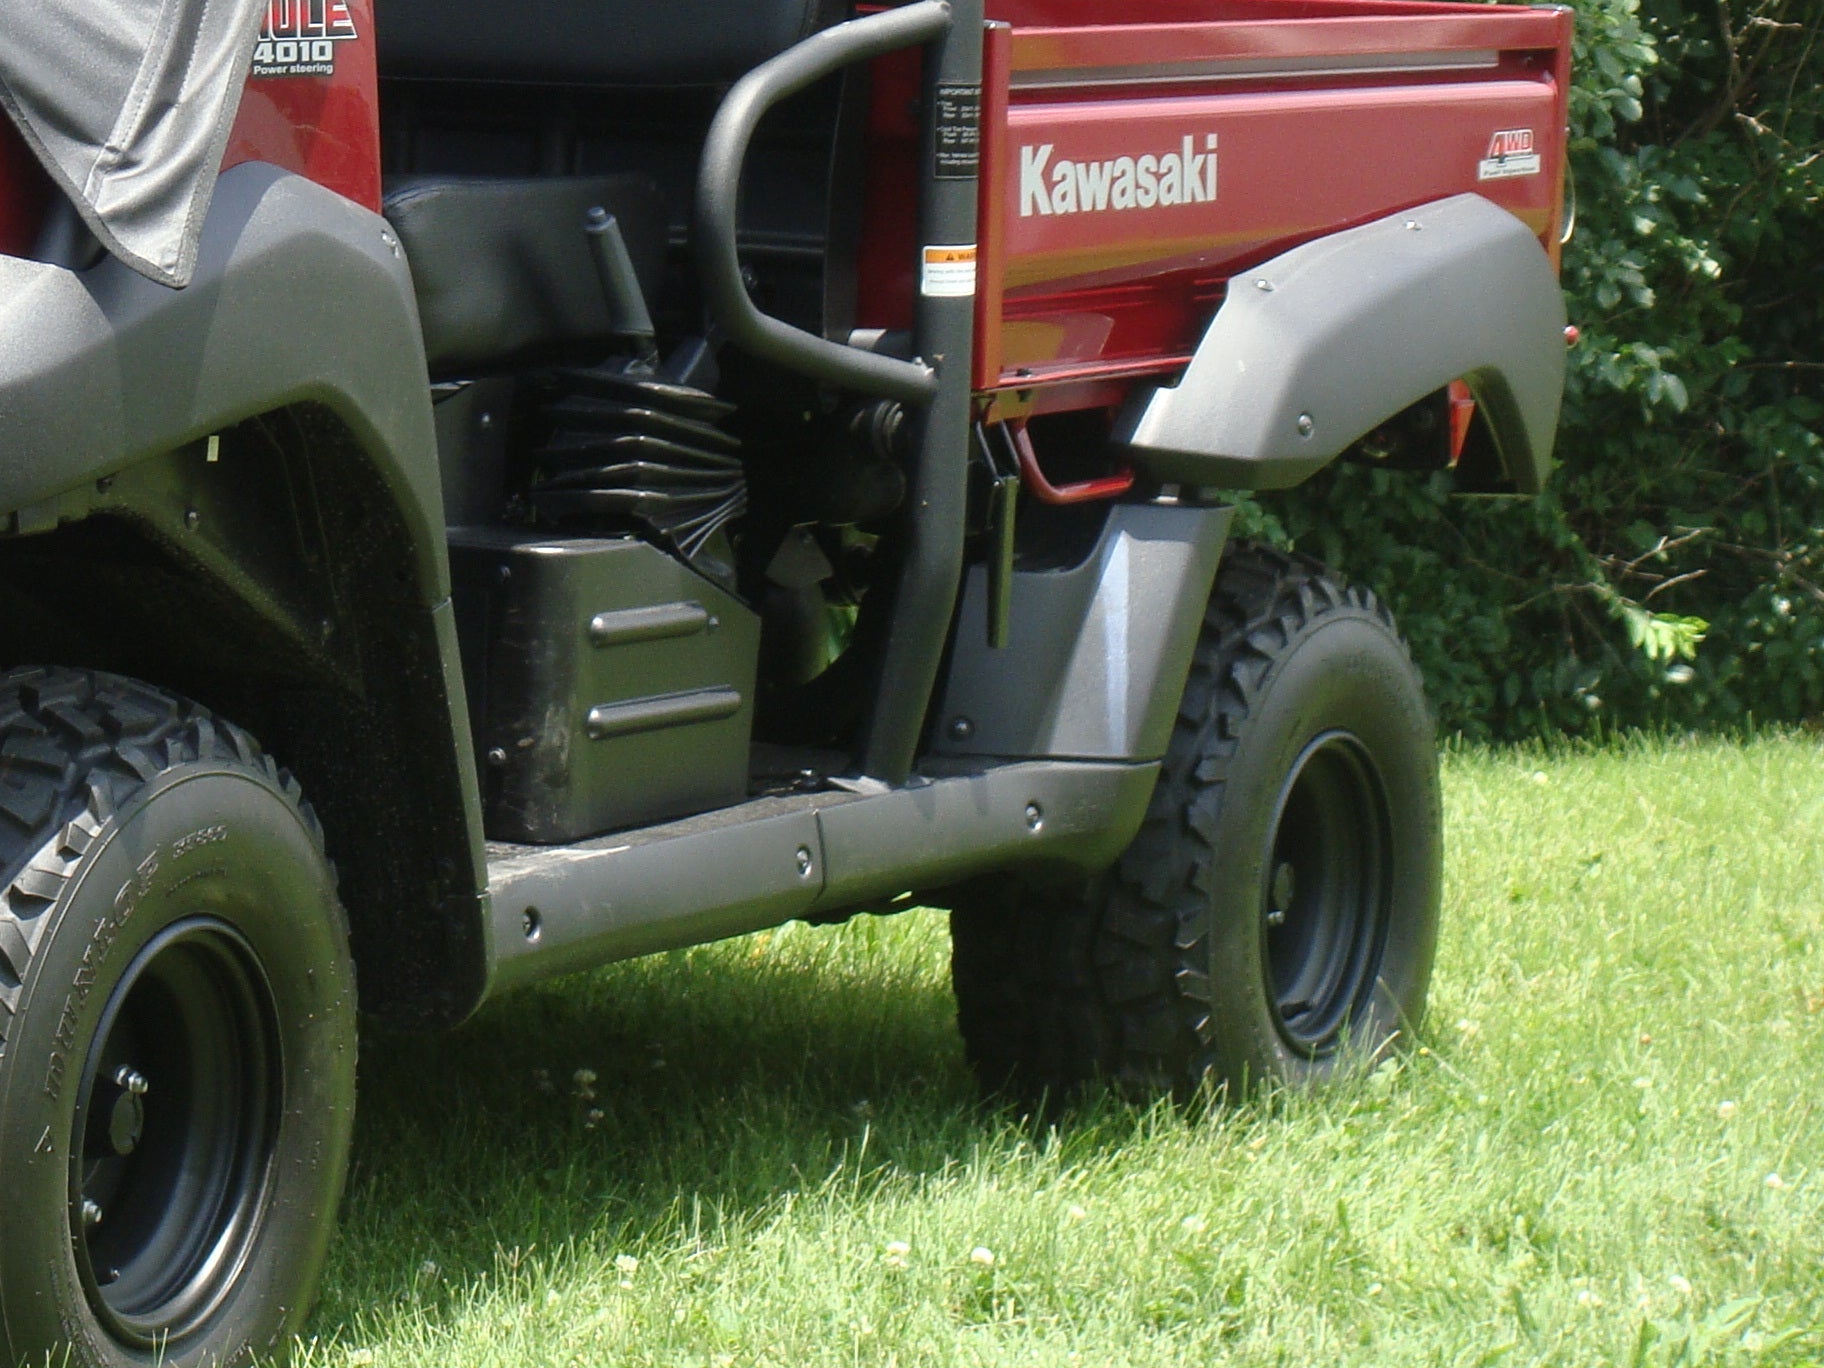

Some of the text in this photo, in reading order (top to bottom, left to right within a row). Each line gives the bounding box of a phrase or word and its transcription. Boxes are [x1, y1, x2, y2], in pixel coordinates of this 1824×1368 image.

[253, 41, 333, 63] 4010
[253, 63, 333, 75] Power steering
[1020, 133, 1217, 217] Kawasaki
